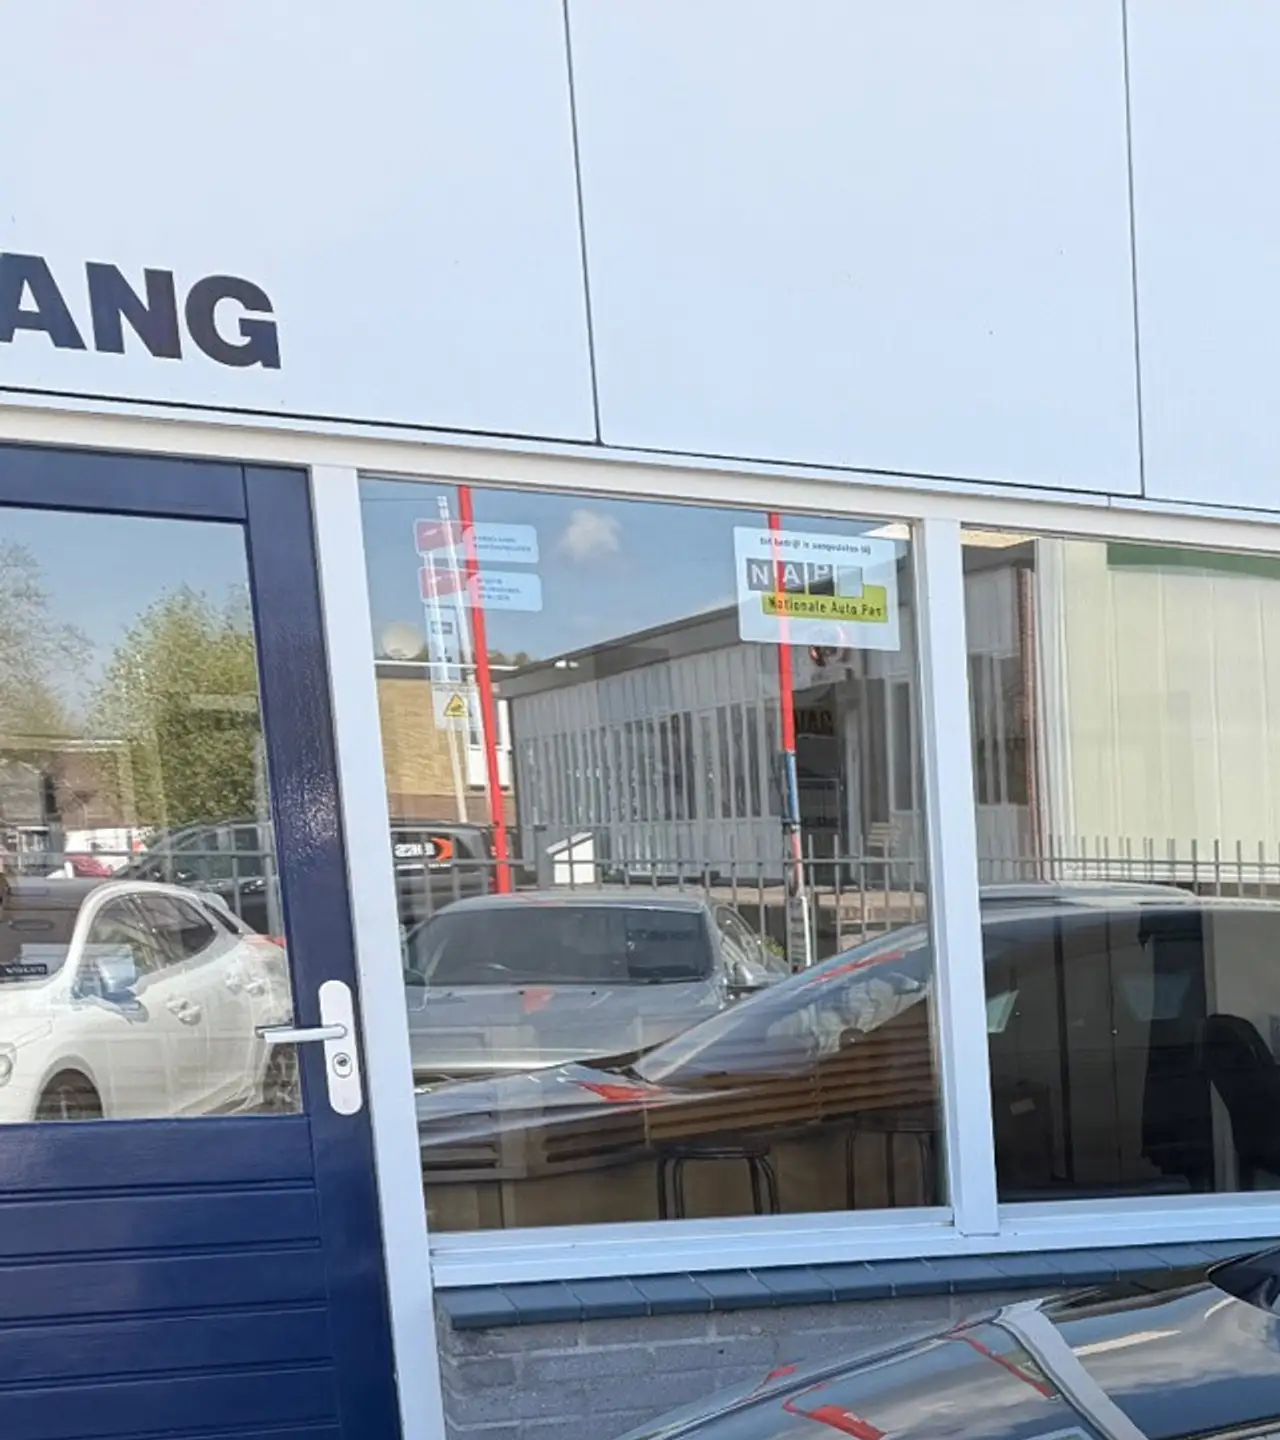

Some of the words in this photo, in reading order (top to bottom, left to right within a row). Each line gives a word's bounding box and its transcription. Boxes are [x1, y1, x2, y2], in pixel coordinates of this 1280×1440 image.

[0, 252, 281, 370] ANG
[768, 597, 827, 613] Nationale
[831, 601, 858, 615] Auto
[862, 603, 882, 617] Pas
